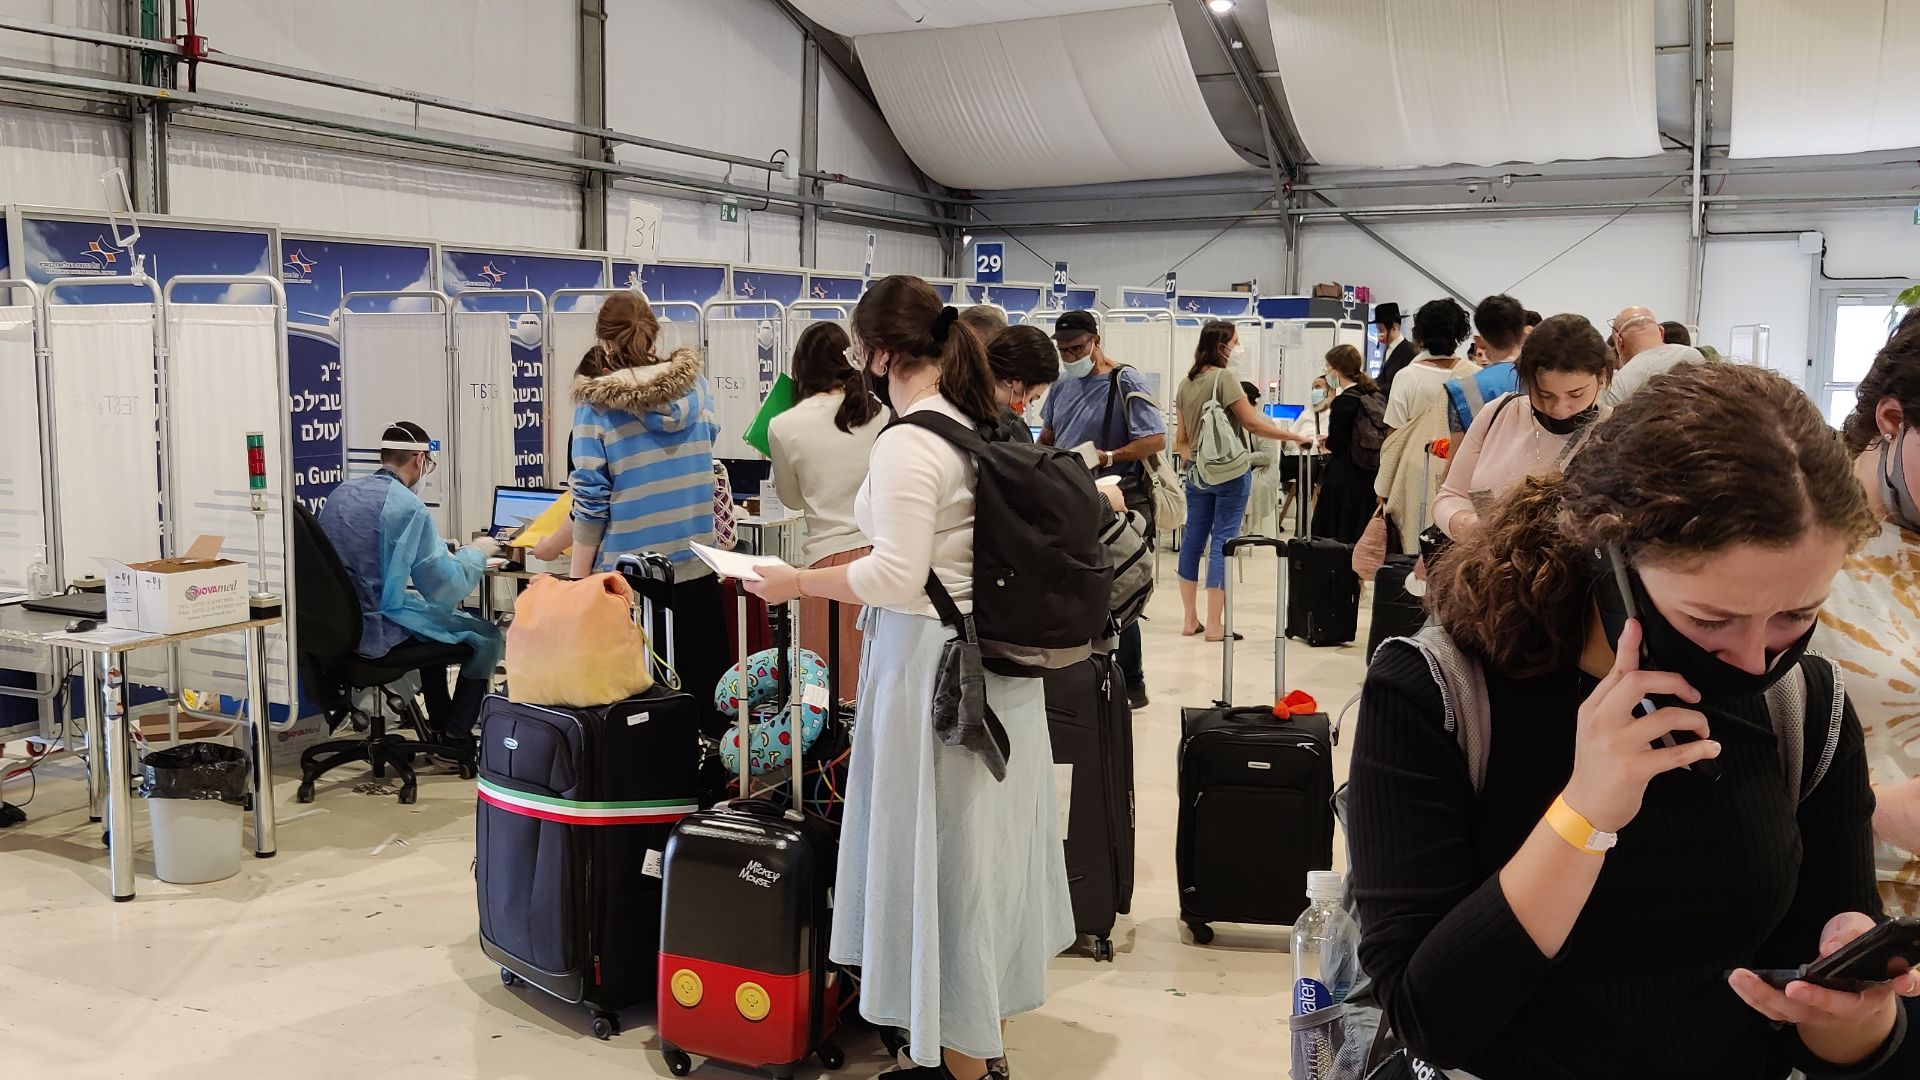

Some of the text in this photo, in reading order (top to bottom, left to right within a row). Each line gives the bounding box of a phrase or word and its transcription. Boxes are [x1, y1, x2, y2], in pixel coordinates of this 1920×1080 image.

[632, 216, 656, 250] 31
[977, 254, 1002, 273] 29
[1054, 270, 1067, 285] 28
[1165, 279, 1176, 293] 27
[1343, 291, 1354, 302] 25
[301, 418, 342, 442] עולם
[308, 464, 345, 485] Guri
